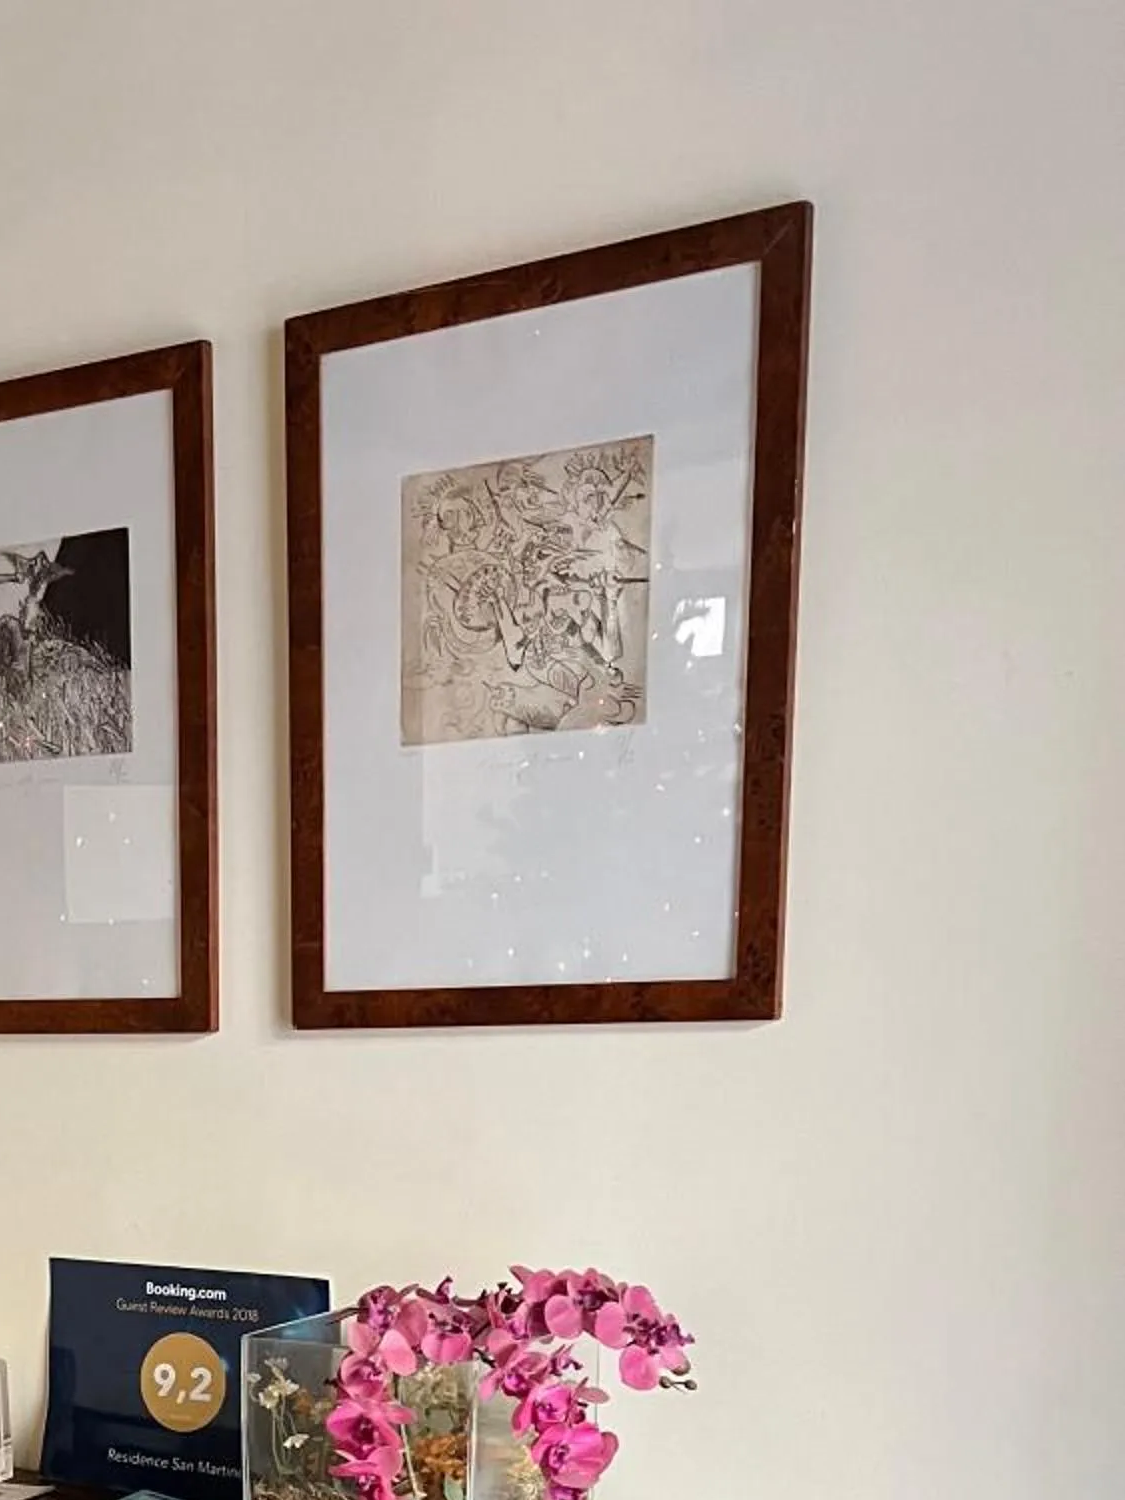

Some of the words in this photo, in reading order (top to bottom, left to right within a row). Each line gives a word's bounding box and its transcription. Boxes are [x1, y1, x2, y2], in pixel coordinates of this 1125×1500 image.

[146, 1281, 226, 1300] Booking.com
[115, 1298, 148, 1313] Guest
[150, 1301, 186, 1316] Review
[188, 1304, 229, 1320] Awards
[232, 1307, 260, 1323] 2018
[153, 1362, 213, 1405] 9,2
[107, 1448, 169, 1470] Residence
[171, 1457, 194, 1473] San
